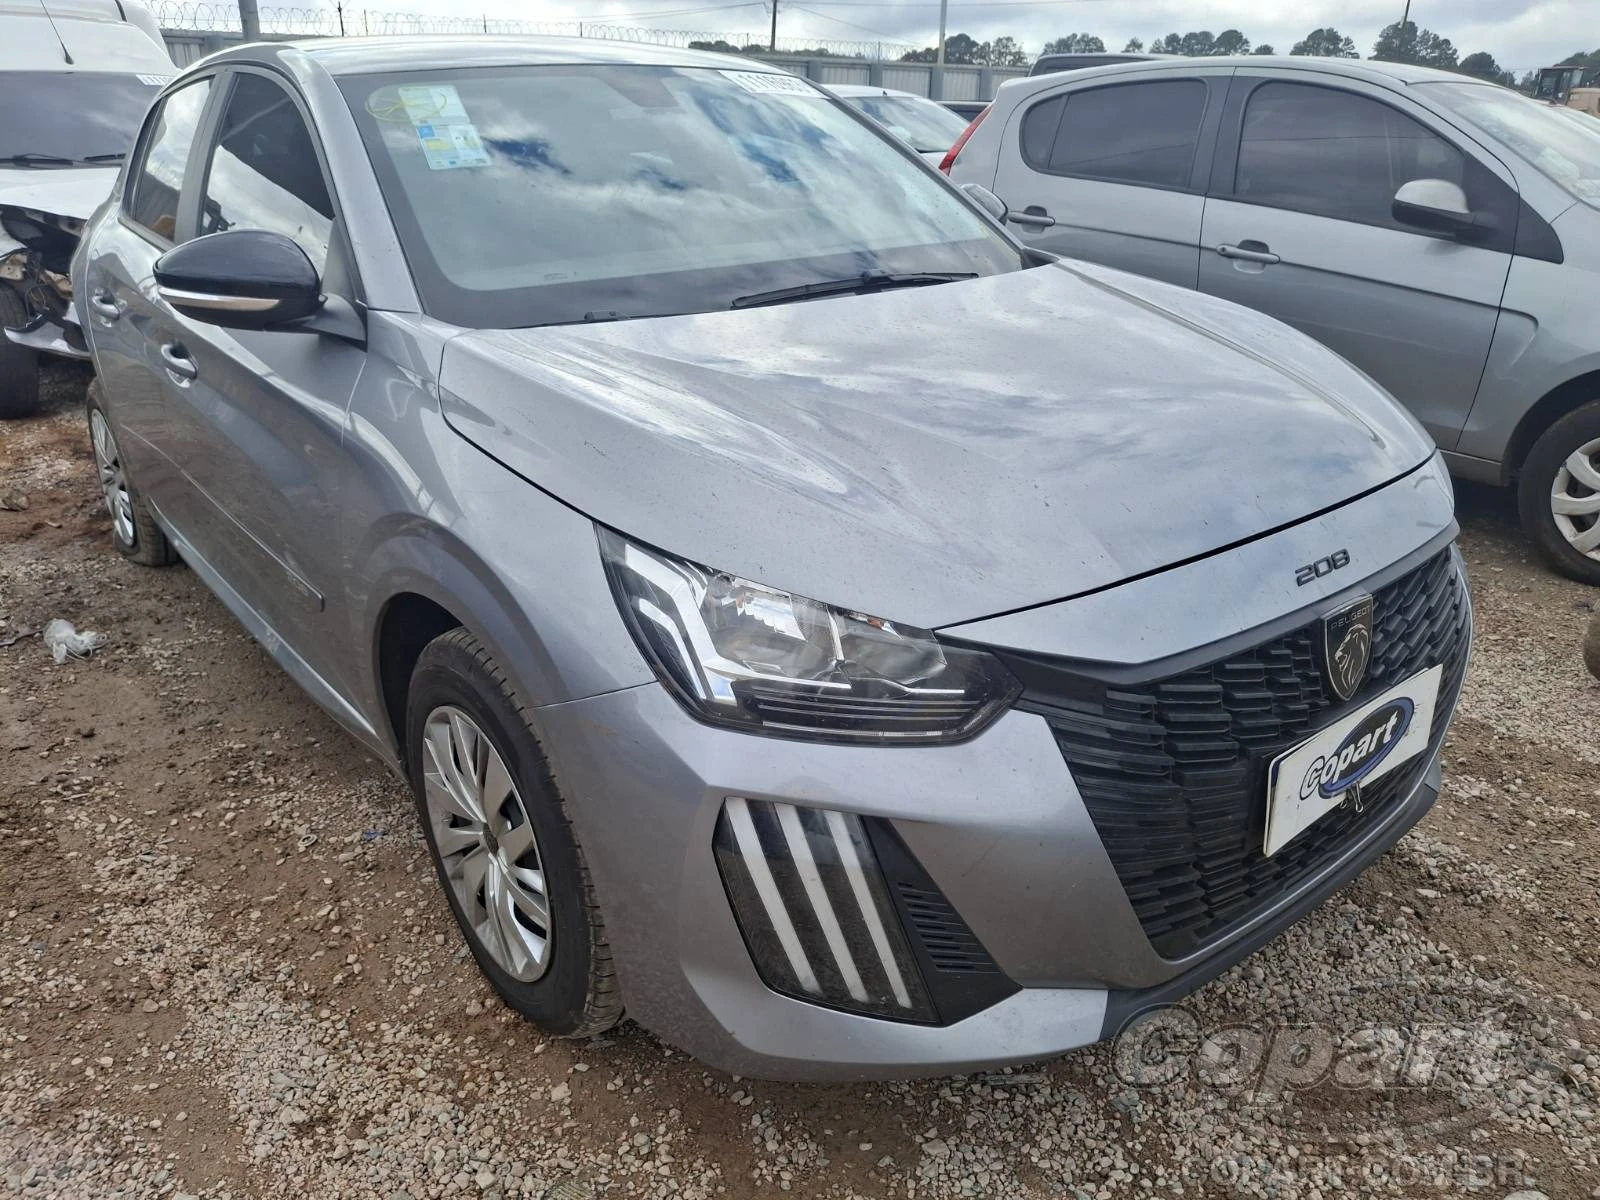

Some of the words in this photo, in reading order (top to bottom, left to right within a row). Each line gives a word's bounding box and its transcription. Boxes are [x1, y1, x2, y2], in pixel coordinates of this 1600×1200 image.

[1295, 549, 1350, 586] 208
[1330, 605, 1370, 631] PEUGEOT
[1300, 710, 1398, 800] Copart
